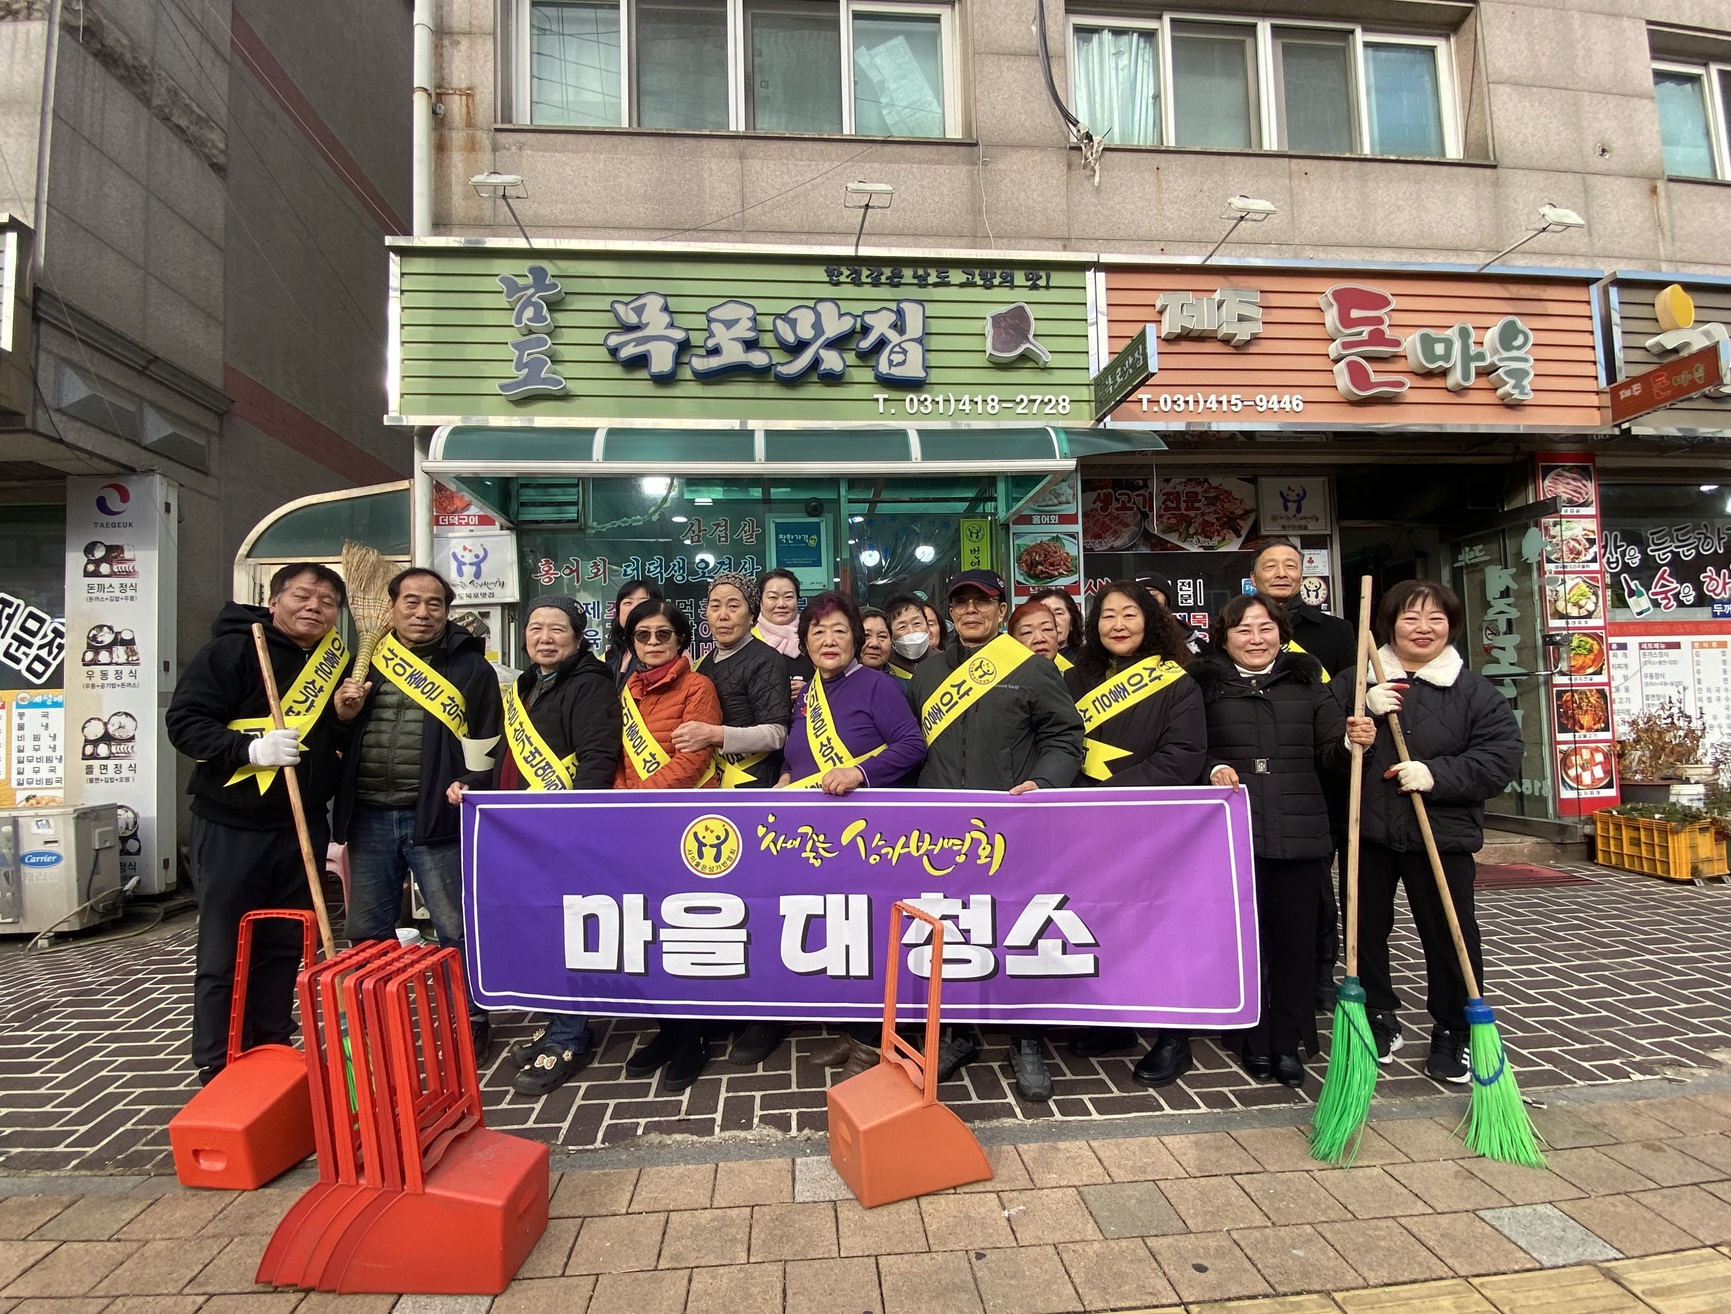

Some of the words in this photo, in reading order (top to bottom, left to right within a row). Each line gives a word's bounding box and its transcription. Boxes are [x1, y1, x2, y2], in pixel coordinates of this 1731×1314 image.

[824, 265, 904, 286] 한결같은
[912, 267, 951, 287] 남도
[959, 268, 1015, 289] 고향의
[1024, 270, 1051, 290] 맛!
[1155, 288, 1263, 346] 제주
[497, 264, 566, 400] 남도
[605, 292, 928, 386] 목포맛집
[874, 394, 895, 414] T.
[905, 394, 1070, 415] 031)418-2728
[1138, 394, 1303, 412] T.031)415-9446
[1092, 491, 1154, 513] 생고기
[1161, 490, 1202, 513] 전문
[439, 516, 479, 526] 더덕구이
[681, 517, 762, 545] 삼겹살
[1032, 514, 1058, 524] 홍어회
[778, 533, 809, 542] 착한가격
[1648, 522, 1731, 563] 든든하
[532, 557, 608, 585] 홍어회
[87, 583, 115, 594] 돈까스
[119, 582, 137, 594] 정식
[314, 631, 345, 682] 이좋은
[563, 892, 751, 979] 마을
[780, 894, 873, 978] 대
[900, 892, 1099, 980] 청소
